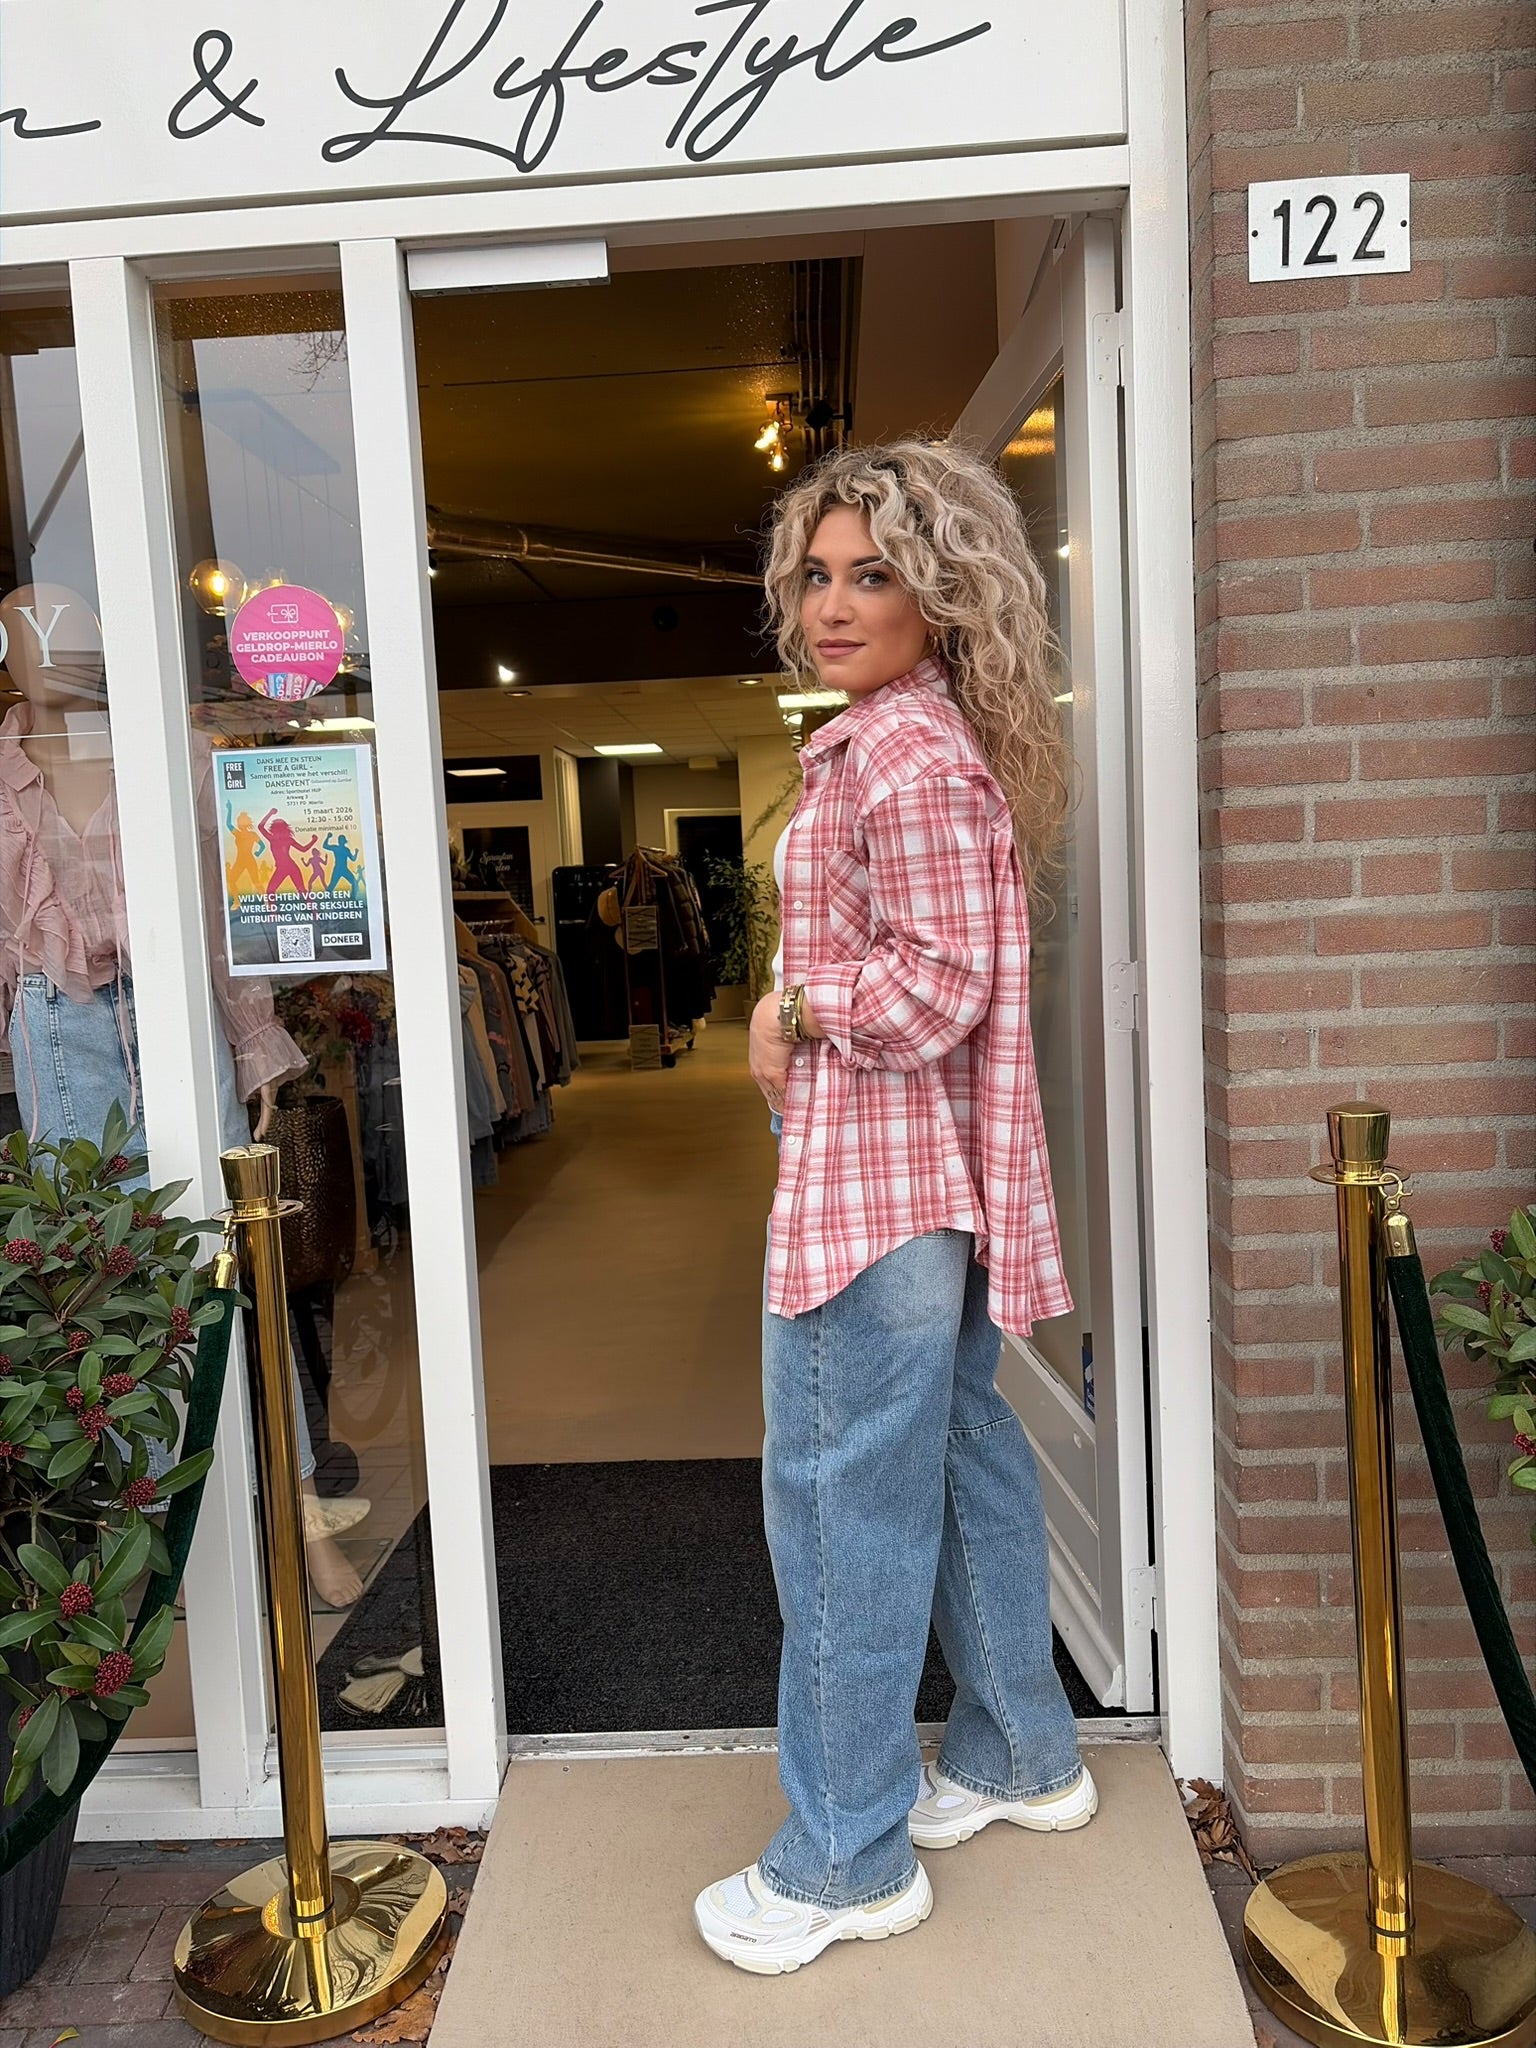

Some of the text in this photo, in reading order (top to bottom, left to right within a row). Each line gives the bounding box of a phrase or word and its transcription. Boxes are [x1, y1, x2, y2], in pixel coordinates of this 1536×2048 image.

[168, 29, 265, 139] &
[1274, 191, 1385, 266] 122
[243, 630, 330, 641] VERKOOPPUNT
[236, 640, 338, 653] GELDROP-MIERLO
[251, 652, 324, 663] CADEAUBON
[225, 762, 243, 771] FREE
[226, 771, 232, 780] A
[227, 780, 244, 789] GIRL
[265, 779, 310, 788] DANSEVENT
[238, 890, 350, 902] WIJ VECHTEN VOOR EEN
[240, 900, 364, 914] WERELD ZONDER SEKSUELE
[240, 911, 363, 924] UITBUITING VAN KINDEREN
[323, 935, 360, 944] DONEER
